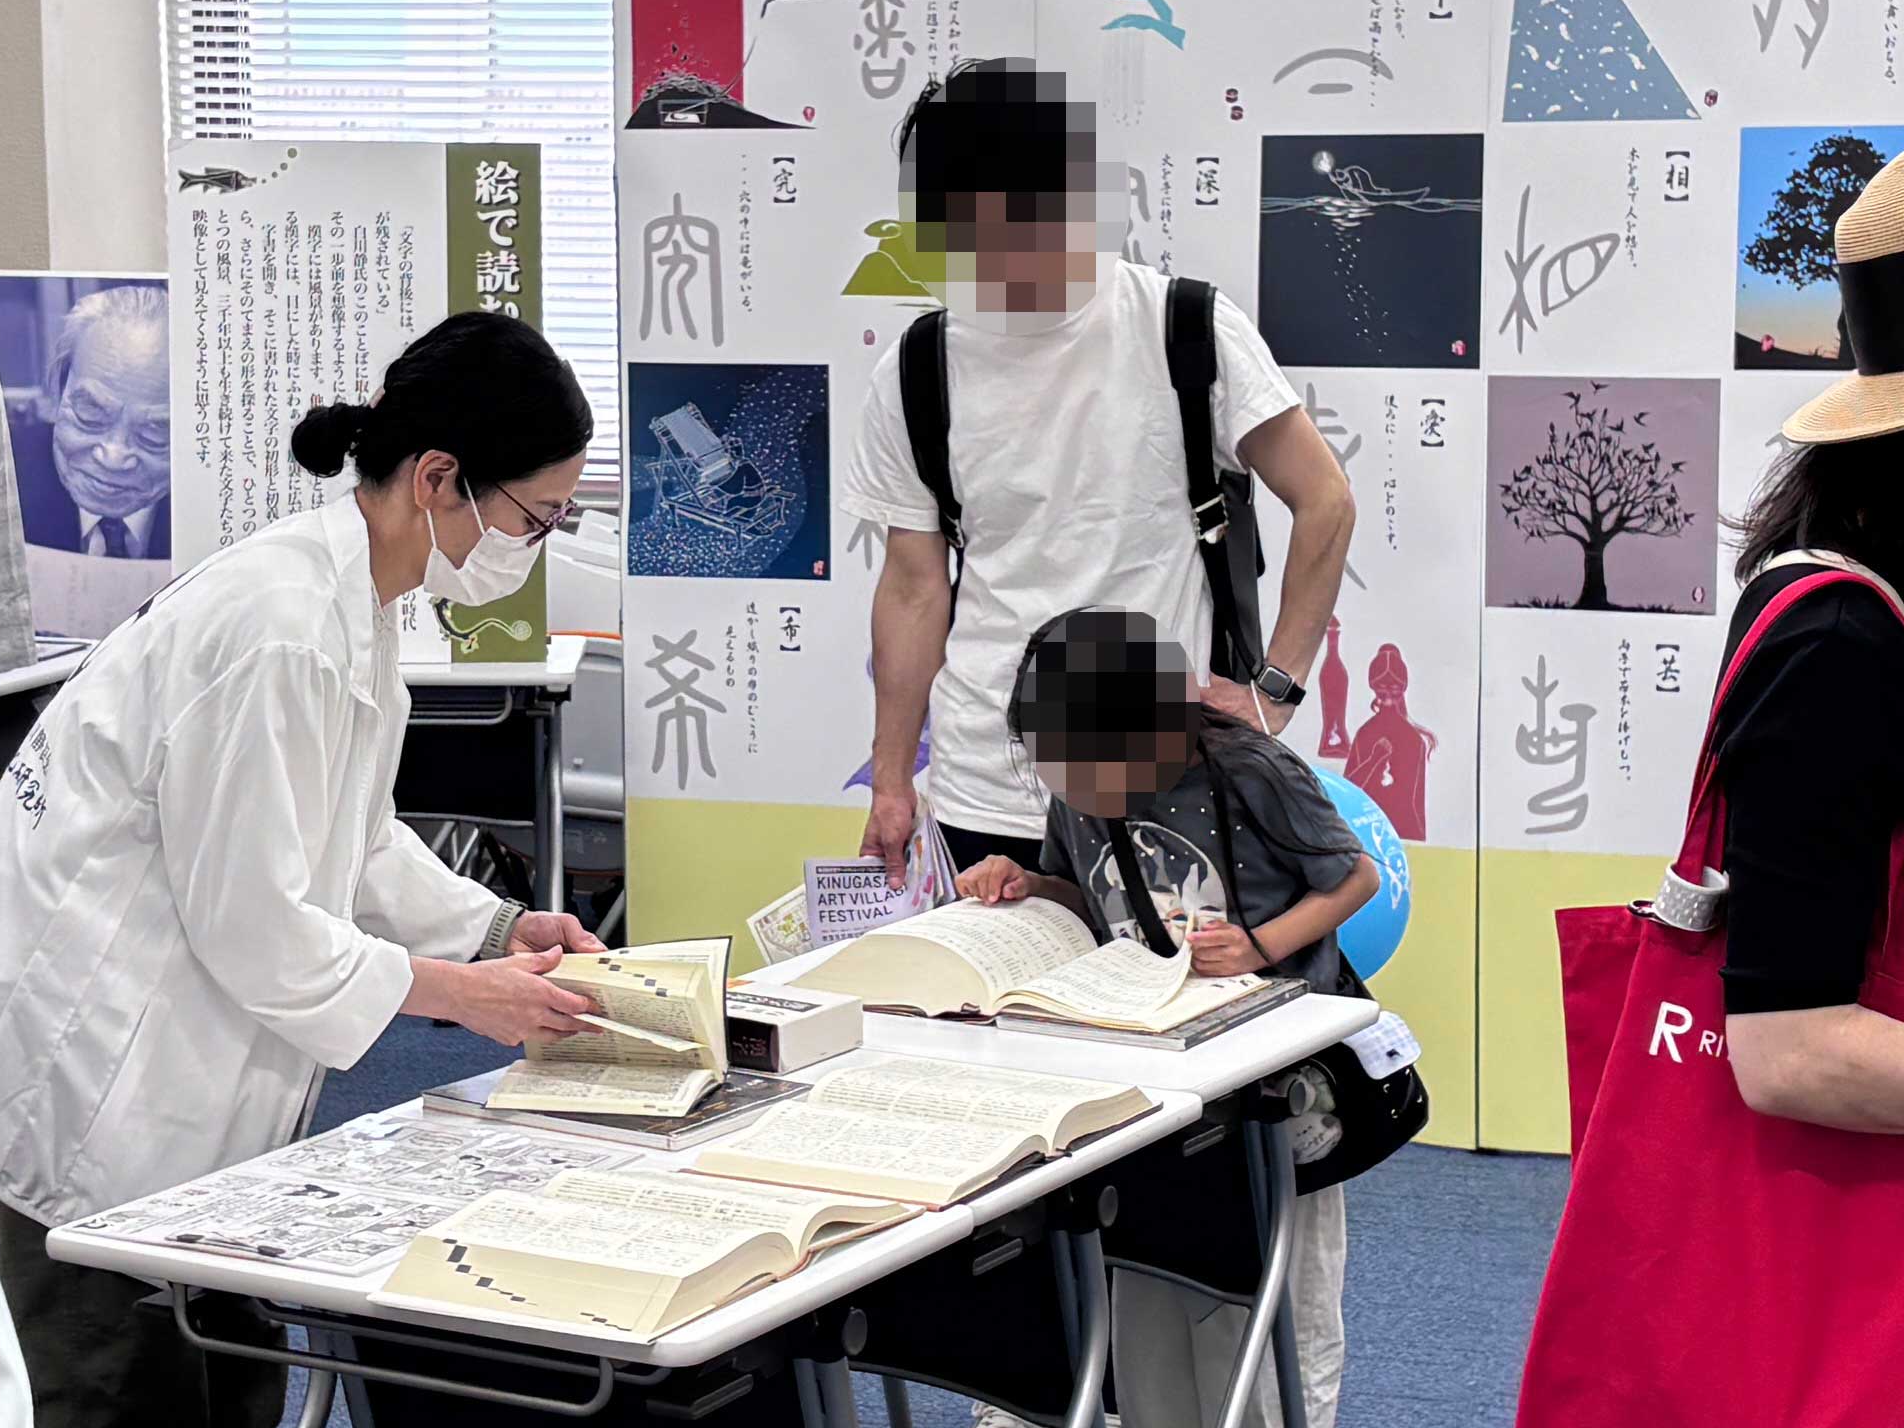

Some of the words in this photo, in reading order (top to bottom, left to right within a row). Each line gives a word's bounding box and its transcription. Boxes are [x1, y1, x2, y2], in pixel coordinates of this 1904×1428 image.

[818, 893, 846, 907] ART
[850, 885, 908, 907] VILLAG
[819, 905, 893, 923] FESTIVAL
[1648, 1001, 1693, 1063] R
